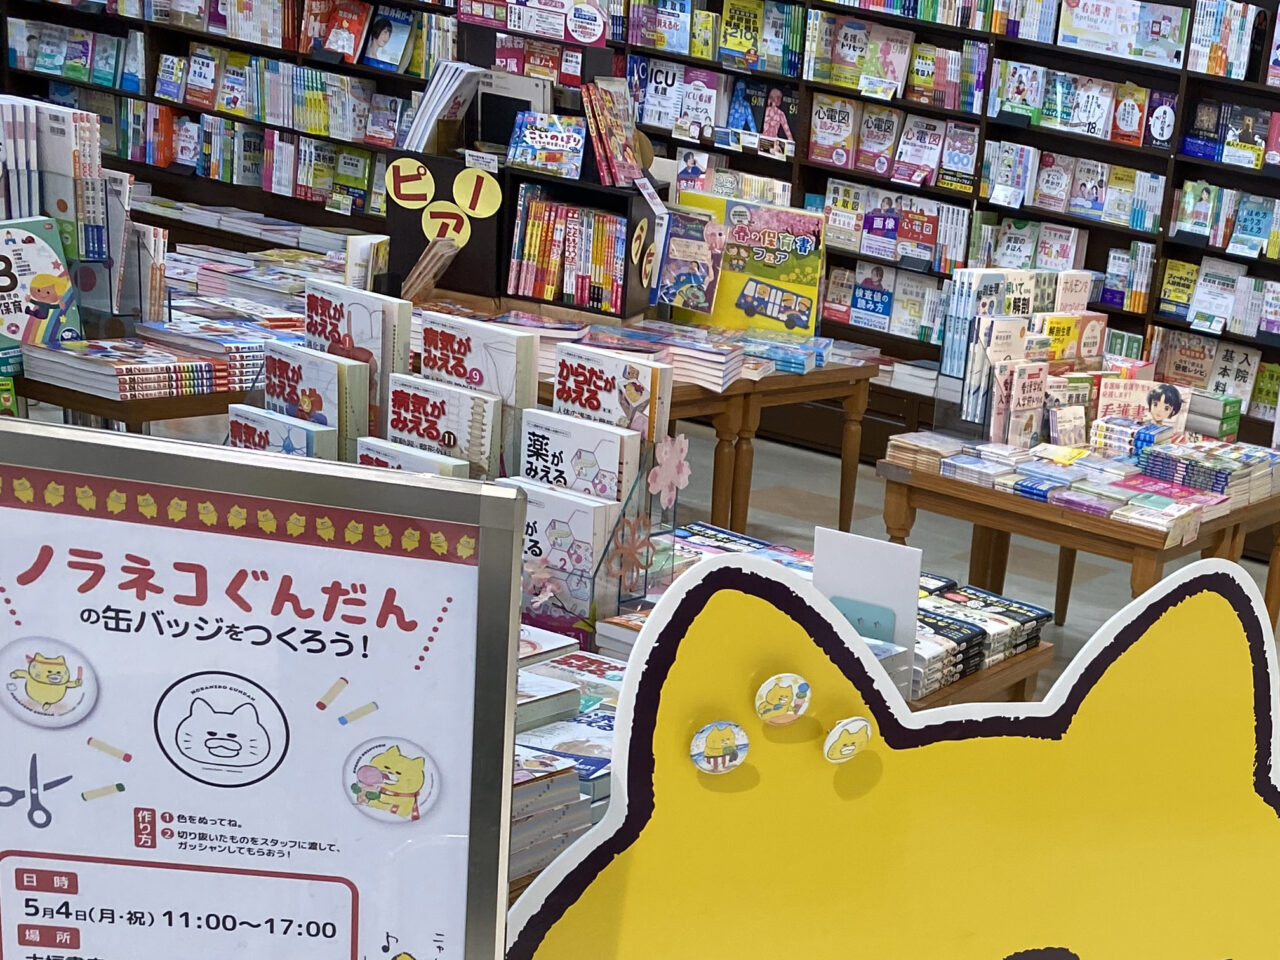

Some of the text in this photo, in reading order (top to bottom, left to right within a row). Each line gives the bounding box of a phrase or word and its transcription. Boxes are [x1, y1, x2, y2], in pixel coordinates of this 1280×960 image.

[649, 68, 676, 87] ICU
[815, 106, 849, 124] 心電図
[864, 115, 894, 133] 心電図
[529, 131, 581, 146] こいのぼり
[904, 128, 941, 145] 心電図
[733, 225, 814, 255] 春の保育書
[754, 248, 788, 264] フェア
[307, 294, 344, 322] 病気が
[306, 315, 342, 343] みえる
[423, 327, 471, 359] 病気が
[266, 356, 303, 384] 病気が
[423, 351, 468, 379] みえる
[559, 359, 615, 393] からだが
[1234, 353, 1251, 383] 入院
[266, 377, 300, 406] みえる
[392, 390, 446, 420] 病気が
[556, 381, 601, 411] みえる
[230, 420, 269, 450] 病気が
[391, 411, 441, 441] みえる
[527, 431, 564, 466] 薬が
[525, 460, 567, 488] みえる
[17, 545, 418, 632] ノラネコぐんだん
[136, 811, 153, 847] 作り方
[177, 813, 243, 829] 色をぬってね。
